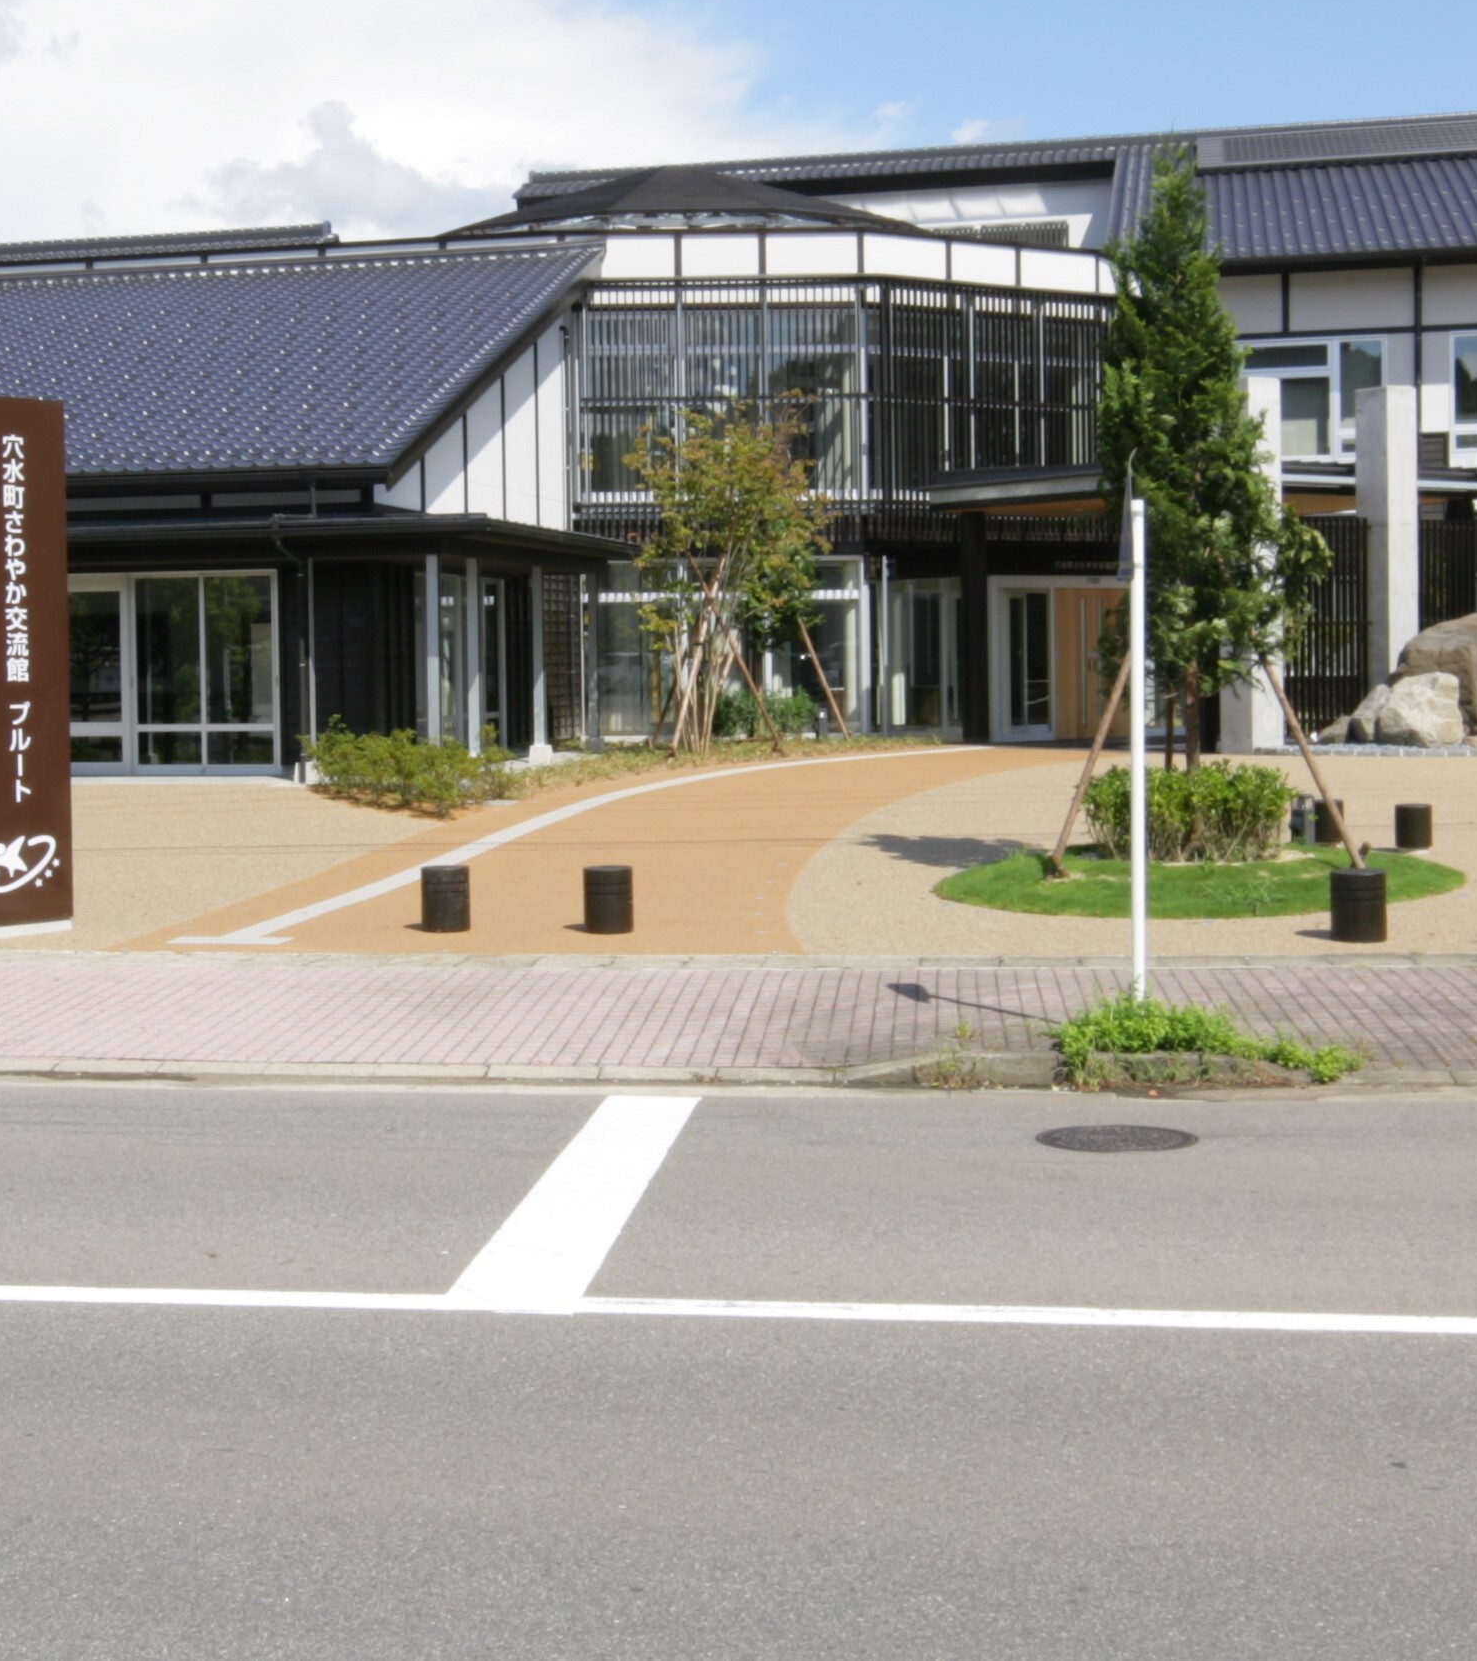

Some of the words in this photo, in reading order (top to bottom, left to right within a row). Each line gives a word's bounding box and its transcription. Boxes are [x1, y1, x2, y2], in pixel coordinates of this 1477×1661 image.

[2, 434, 29, 682] 穴水町さわやか交流館
[9, 701, 31, 803] プルート
